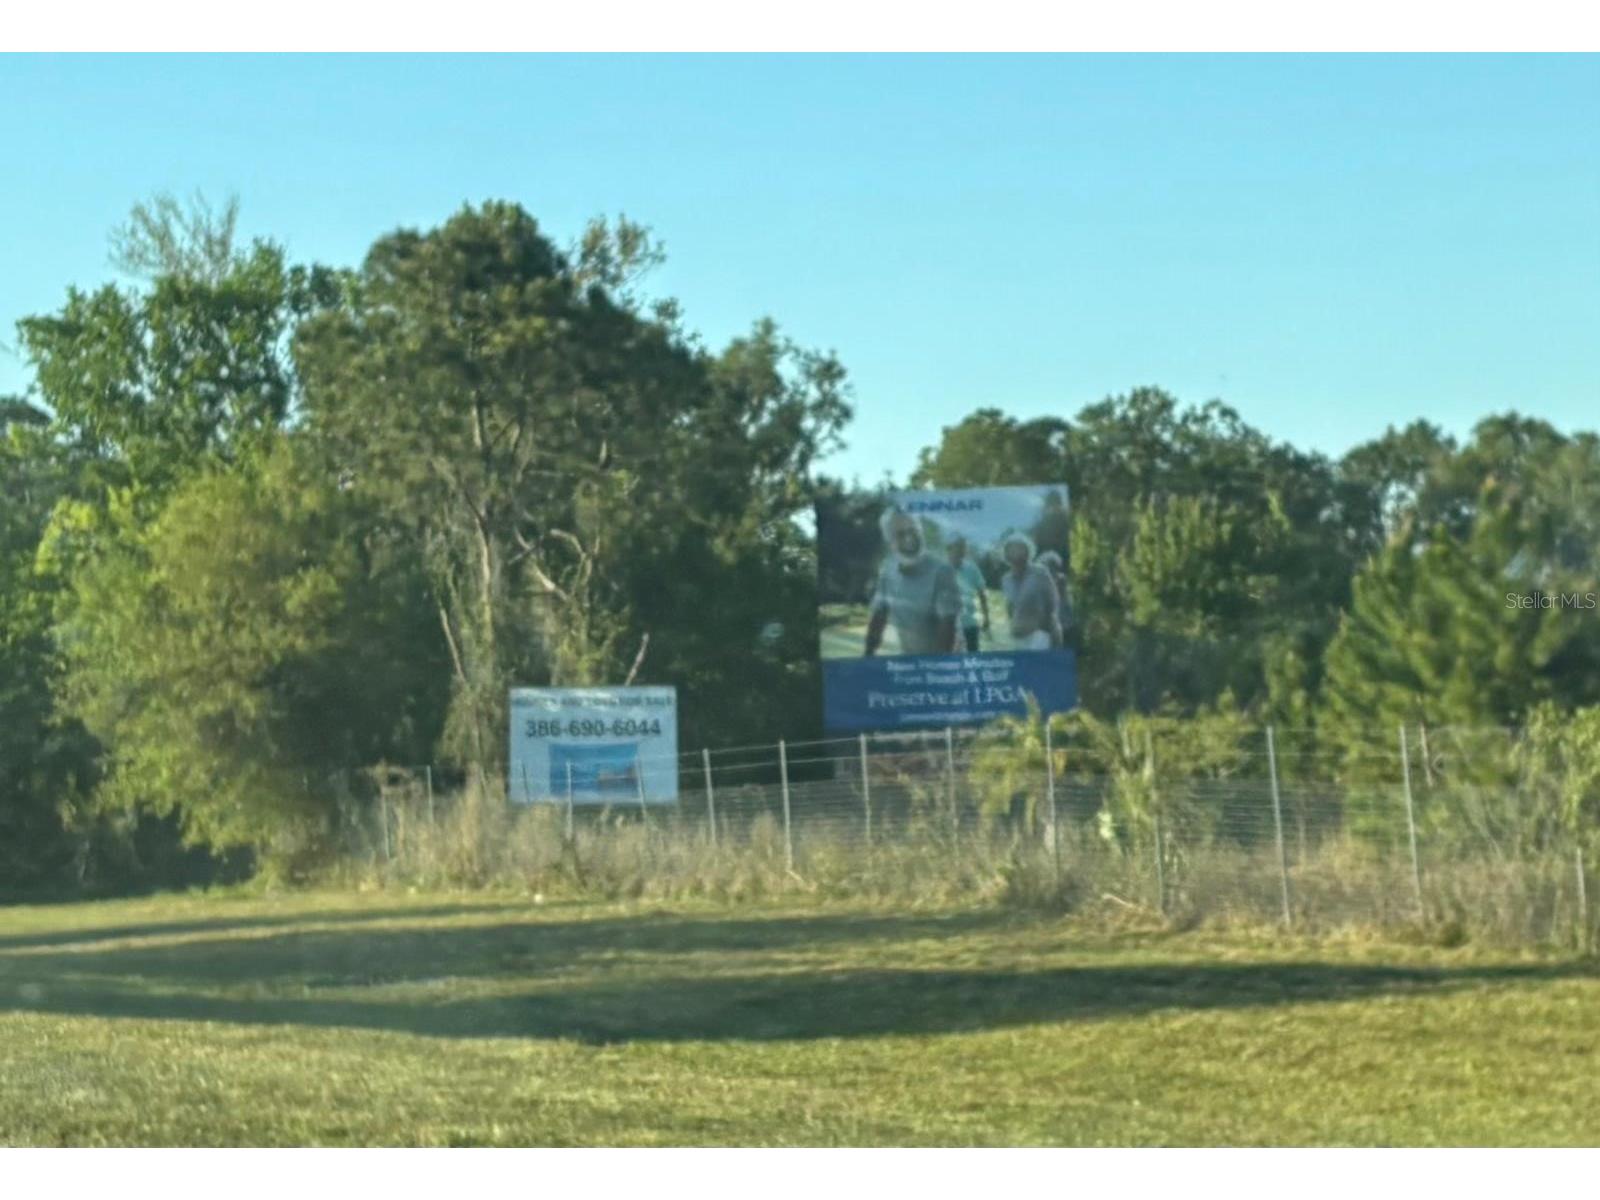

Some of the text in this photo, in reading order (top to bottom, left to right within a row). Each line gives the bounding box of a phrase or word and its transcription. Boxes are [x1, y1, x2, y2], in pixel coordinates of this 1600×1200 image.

[868, 685, 1028, 708] Preserve at LPGA
[525, 719, 661, 738] 386-690-6044
